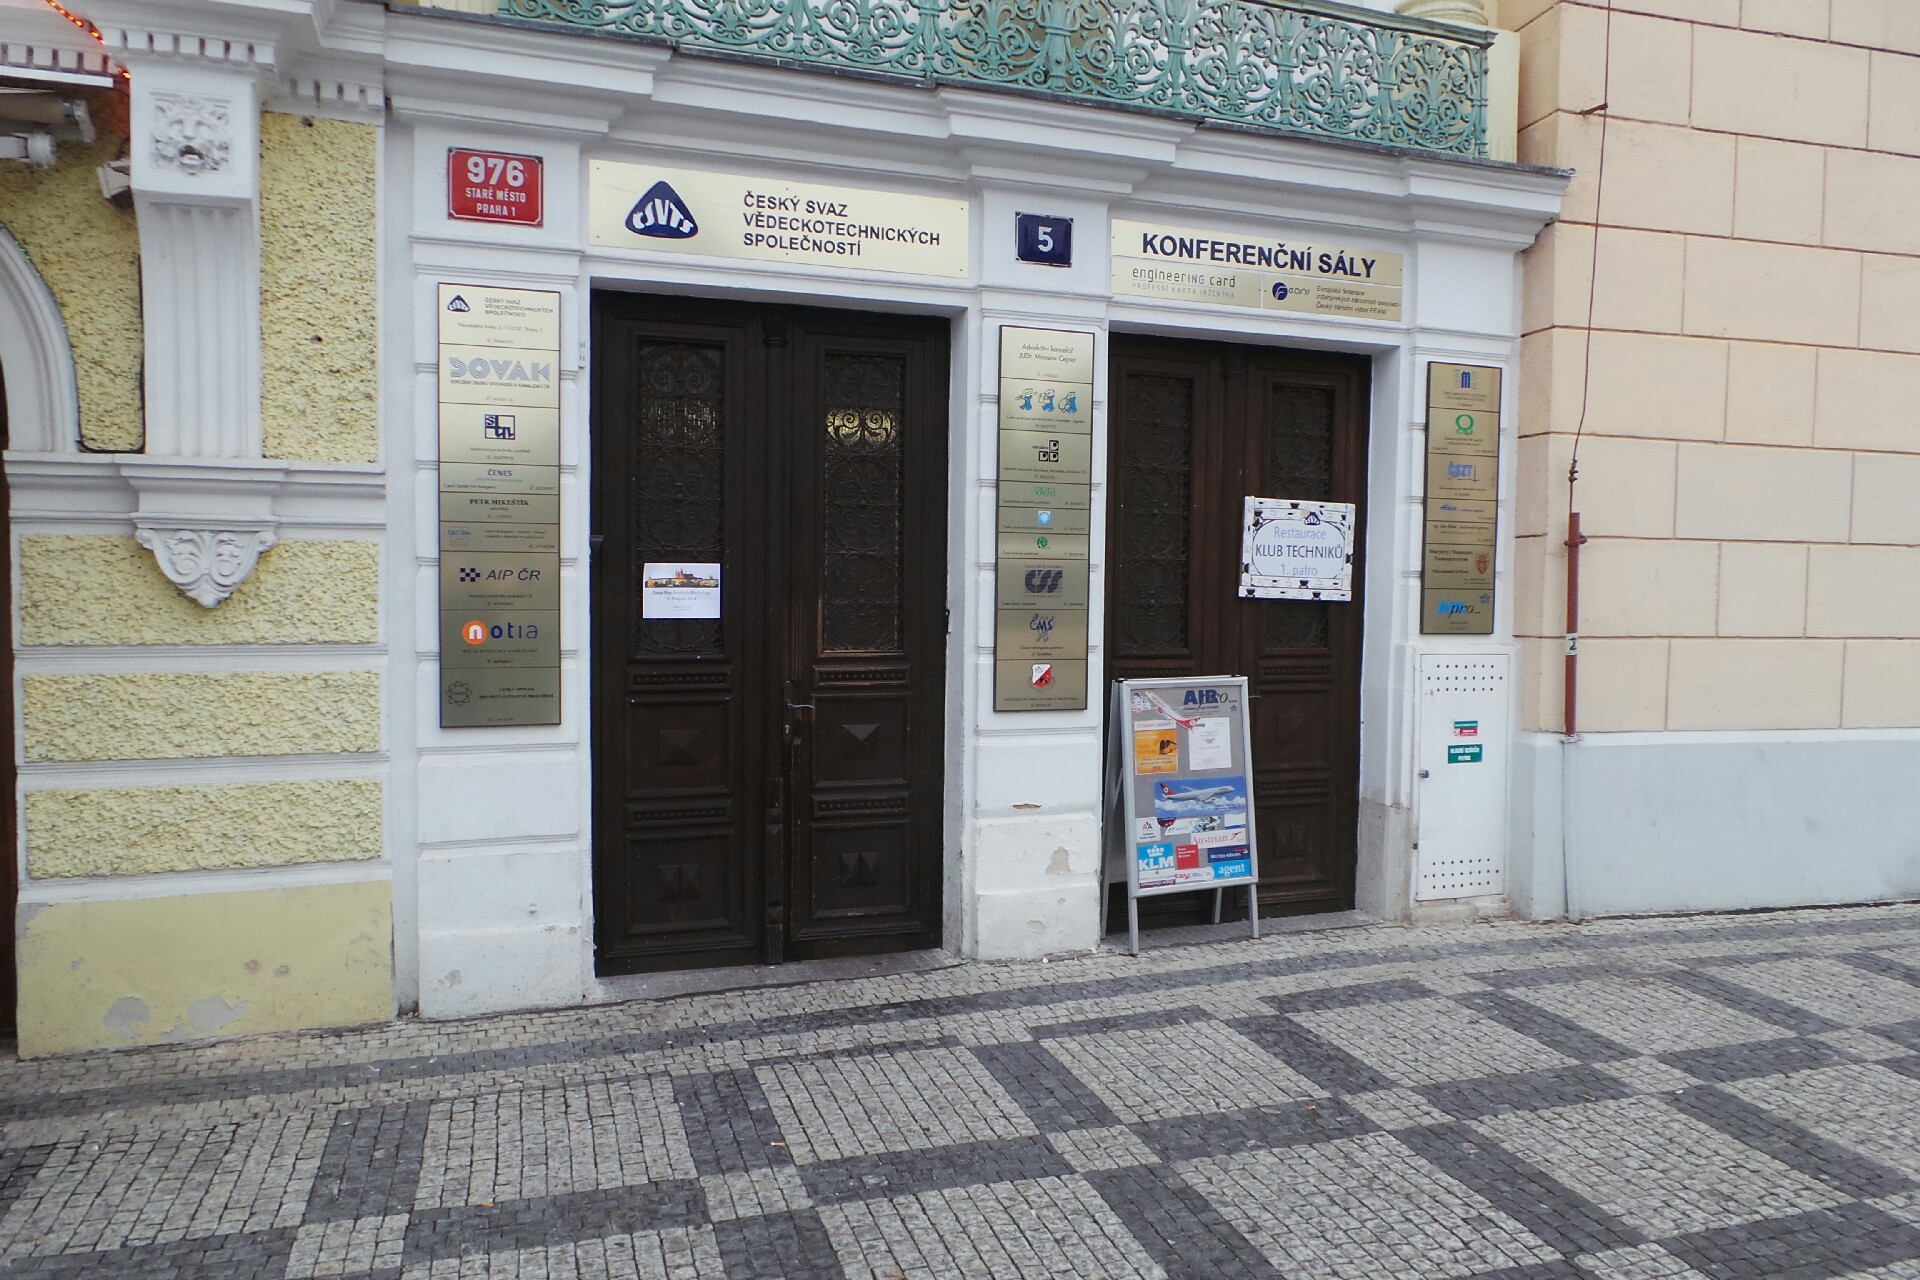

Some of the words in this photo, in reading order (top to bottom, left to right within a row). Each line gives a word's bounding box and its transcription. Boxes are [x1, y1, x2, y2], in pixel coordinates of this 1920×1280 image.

[467, 156, 524, 187] 976
[466, 187, 494, 200] STARÉ
[497, 188, 526, 203] MĚSTO
[476, 203, 508, 216] PRAHA
[511, 207, 516, 216] 1
[743, 190, 800, 212] ČESKÝ
[805, 200, 848, 218] SVAZ
[743, 212, 940, 246] VĚDECKOTECHNICKÝCH
[743, 233, 861, 256] SPOLEČNOSTÍ
[1037, 226, 1054, 253] 5
[1142, 232, 1312, 272] KONFERENČNÍ
[1318, 250, 1376, 279] SÁLY
[1209, 275, 1236, 288] card
[1171, 286, 1198, 295] KARTA
[449, 356, 551, 382] SOVAK
[487, 468, 512, 477] ČENES
[491, 498, 530, 506] MIKEŠTÍK
[1274, 526, 1327, 540] Restaurace
[1255, 544, 1283, 557] KLUB
[1286, 544, 1343, 559] TECHNIKŮ
[486, 569, 514, 580] AIP
[517, 567, 541, 581] ČR
[1281, 563, 1289, 576] 1.
[1292, 565, 1318, 577] patro
[468, 621, 538, 640] notia
[1192, 834, 1228, 846] Austrian
[1138, 855, 1174, 872] KLM
[1218, 863, 1246, 876] agent
